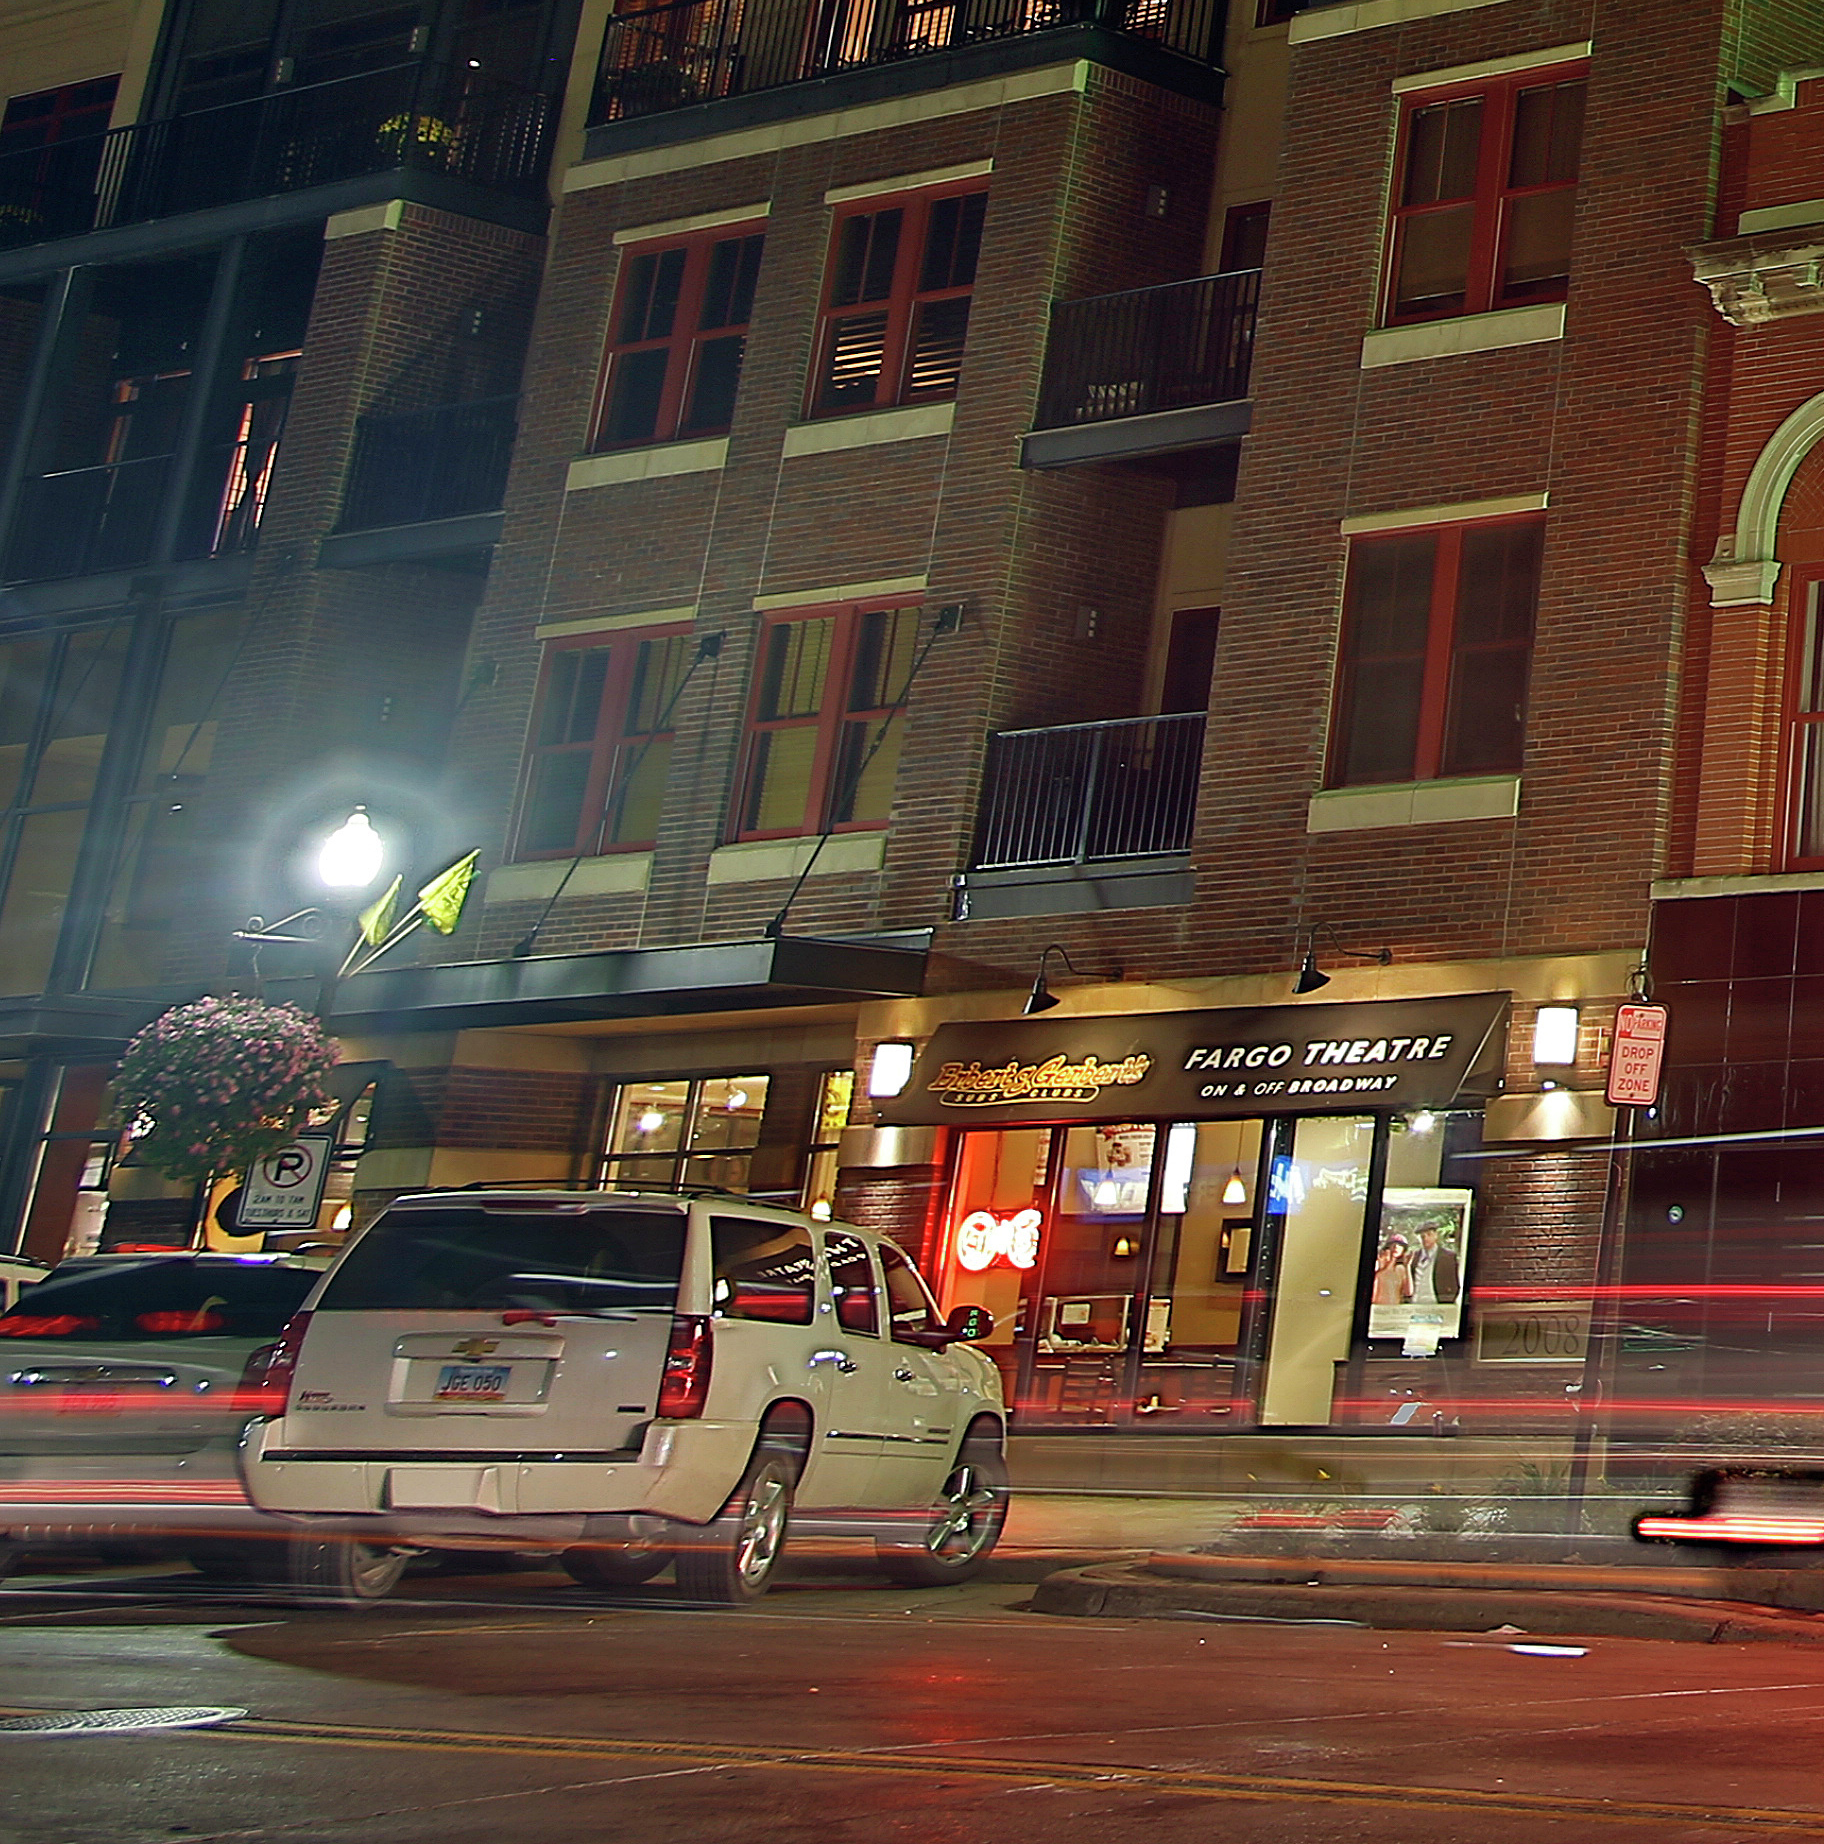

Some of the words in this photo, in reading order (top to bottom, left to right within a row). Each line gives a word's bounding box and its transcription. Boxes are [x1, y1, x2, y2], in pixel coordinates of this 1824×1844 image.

[1184, 1044, 1293, 1070] FARGO
[1303, 1035, 1452, 1066] THEATRE
[1621, 1046, 1655, 1060] DROP
[1624, 1062, 1649, 1075] OFF
[1200, 1083, 1229, 1097] ON
[1233, 1084, 1247, 1097] &
[1253, 1081, 1286, 1096] OFF
[1286, 1074, 1398, 1095] BROADWAY
[1617, 1077, 1650, 1092] ZONE
[954, 1092, 999, 1103] SUBS
[1029, 1087, 1084, 1099] CLUBS
[1502, 1314, 1581, 1356] 2008
[441, 1375, 470, 1393] JGE
[473, 1375, 502, 1391] 050
